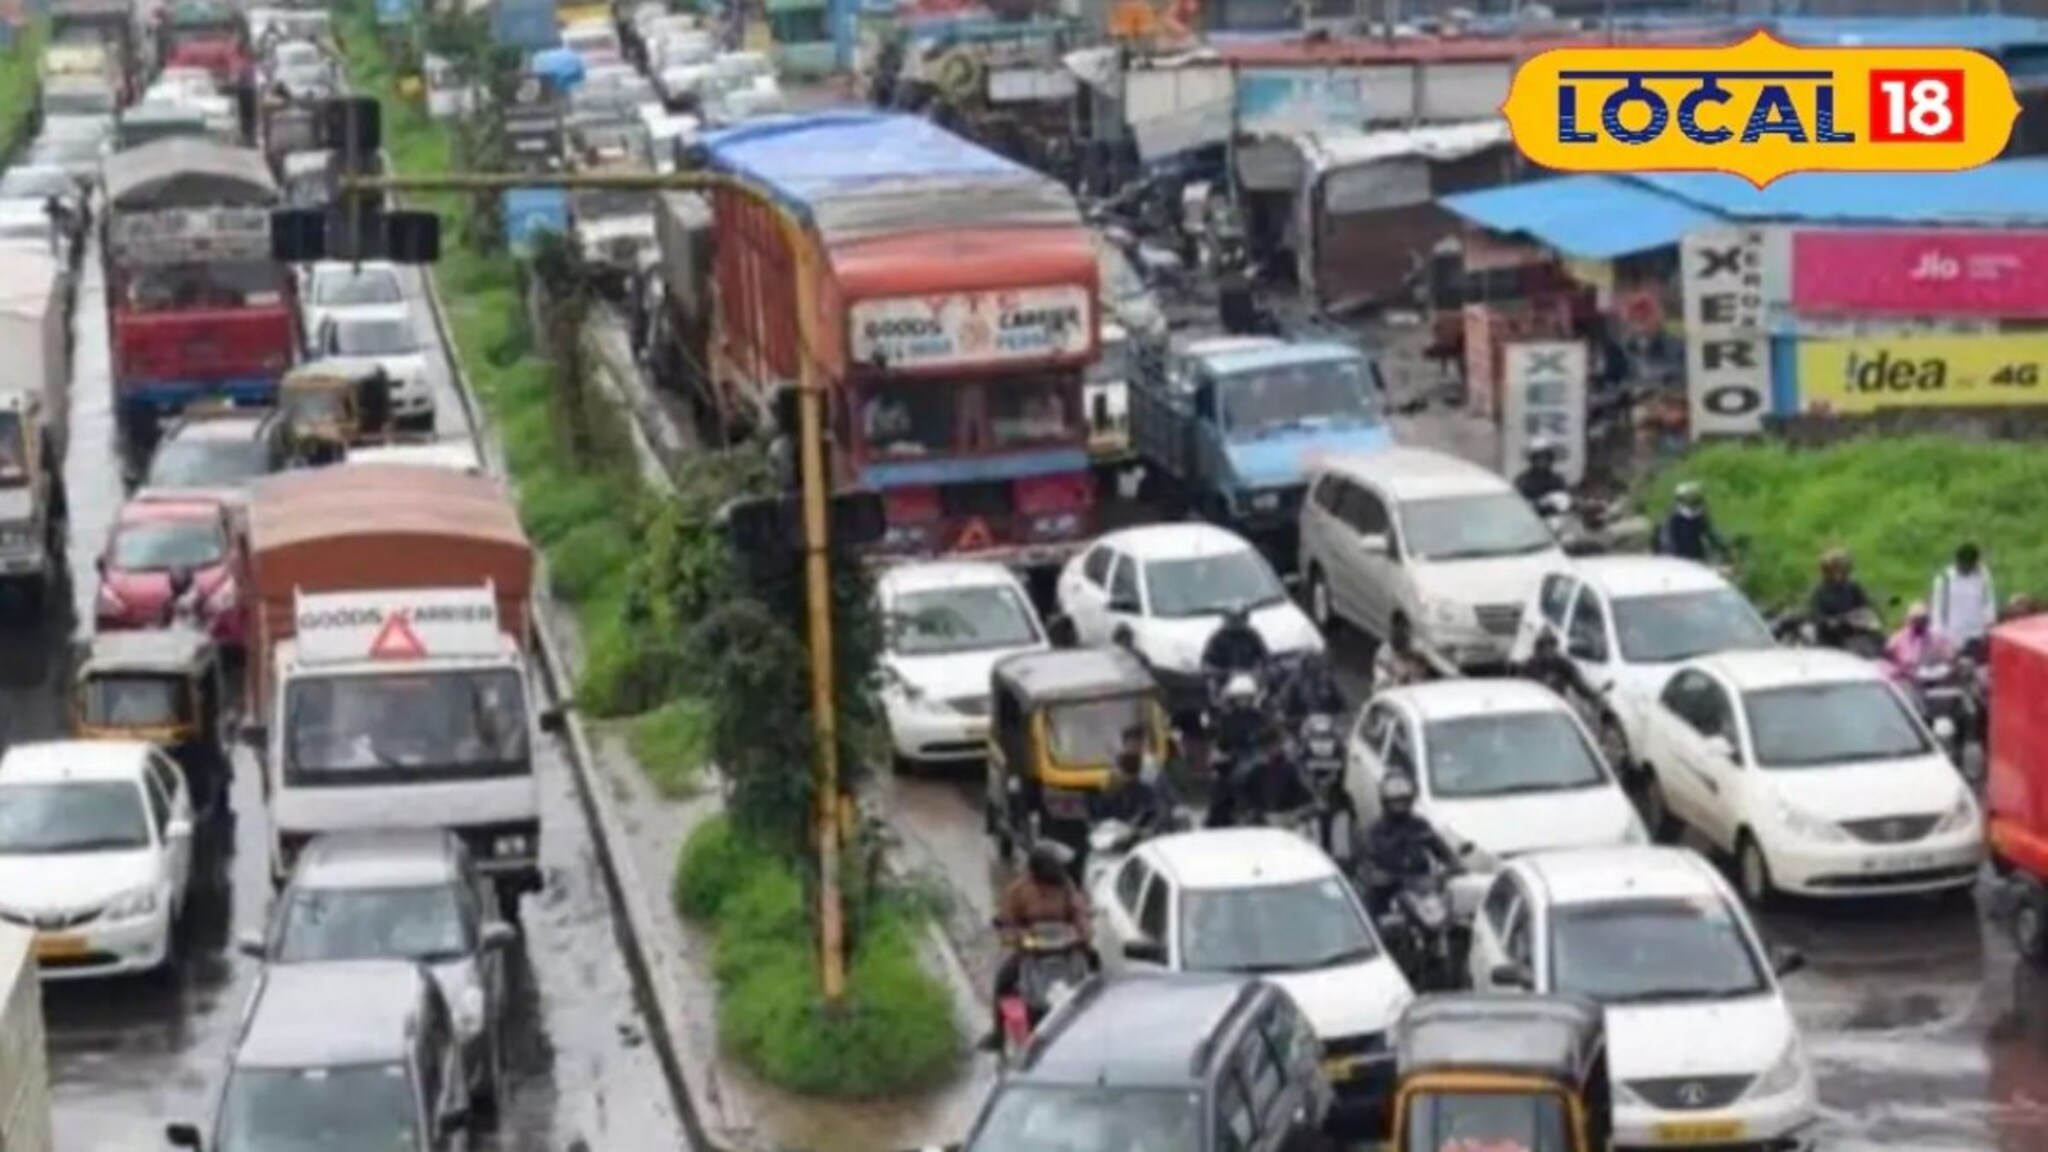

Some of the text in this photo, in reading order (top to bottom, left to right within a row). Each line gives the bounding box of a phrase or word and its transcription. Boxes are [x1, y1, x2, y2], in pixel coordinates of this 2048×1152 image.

[863, 317, 944, 340] GOODS
[1698, 246, 1762, 417] XERO
[1990, 362, 2040, 388] 4G
[299, 607, 383, 631] GOODS
